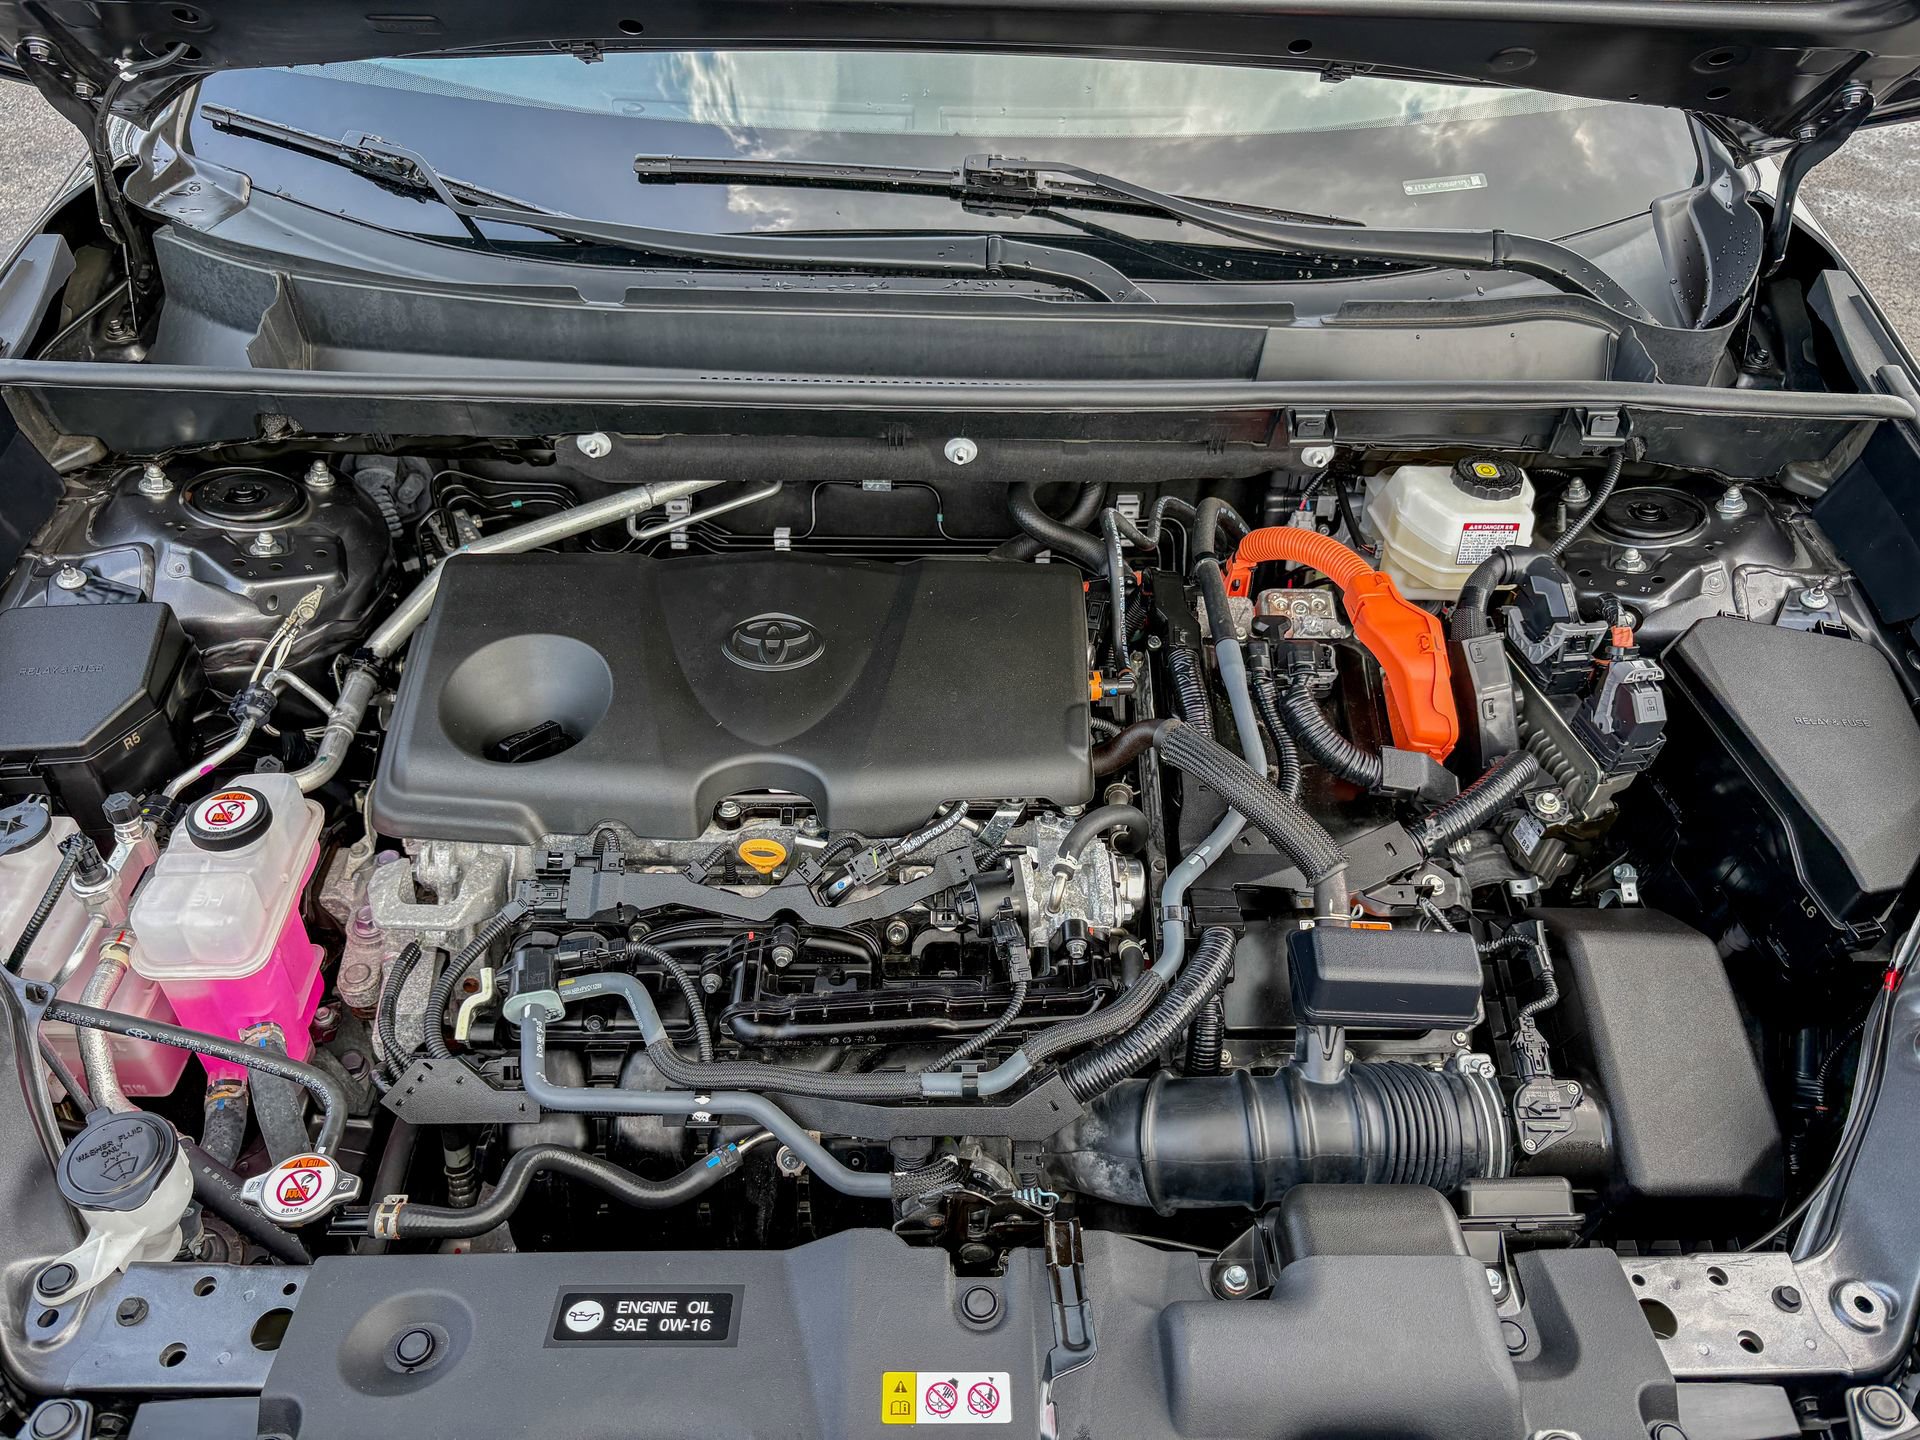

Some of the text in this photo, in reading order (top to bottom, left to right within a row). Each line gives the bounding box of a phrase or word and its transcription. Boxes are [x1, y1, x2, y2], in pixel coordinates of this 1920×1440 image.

[20, 665, 60, 677] RELAY
[72, 664, 104, 674] FUSE
[1793, 716, 1829, 727] RELAY
[1841, 718, 1870, 729] FUSE
[123, 731, 141, 751] R5
[1799, 895, 1817, 919] L6
[172, 1034, 201, 1049] WATER
[75, 1125, 144, 1164] WASHER FLUID
[100, 1142, 125, 1159] ONLY
[616, 1300, 715, 1314] ENGINE OIL
[613, 1318, 712, 1332] SAE 0W-16
